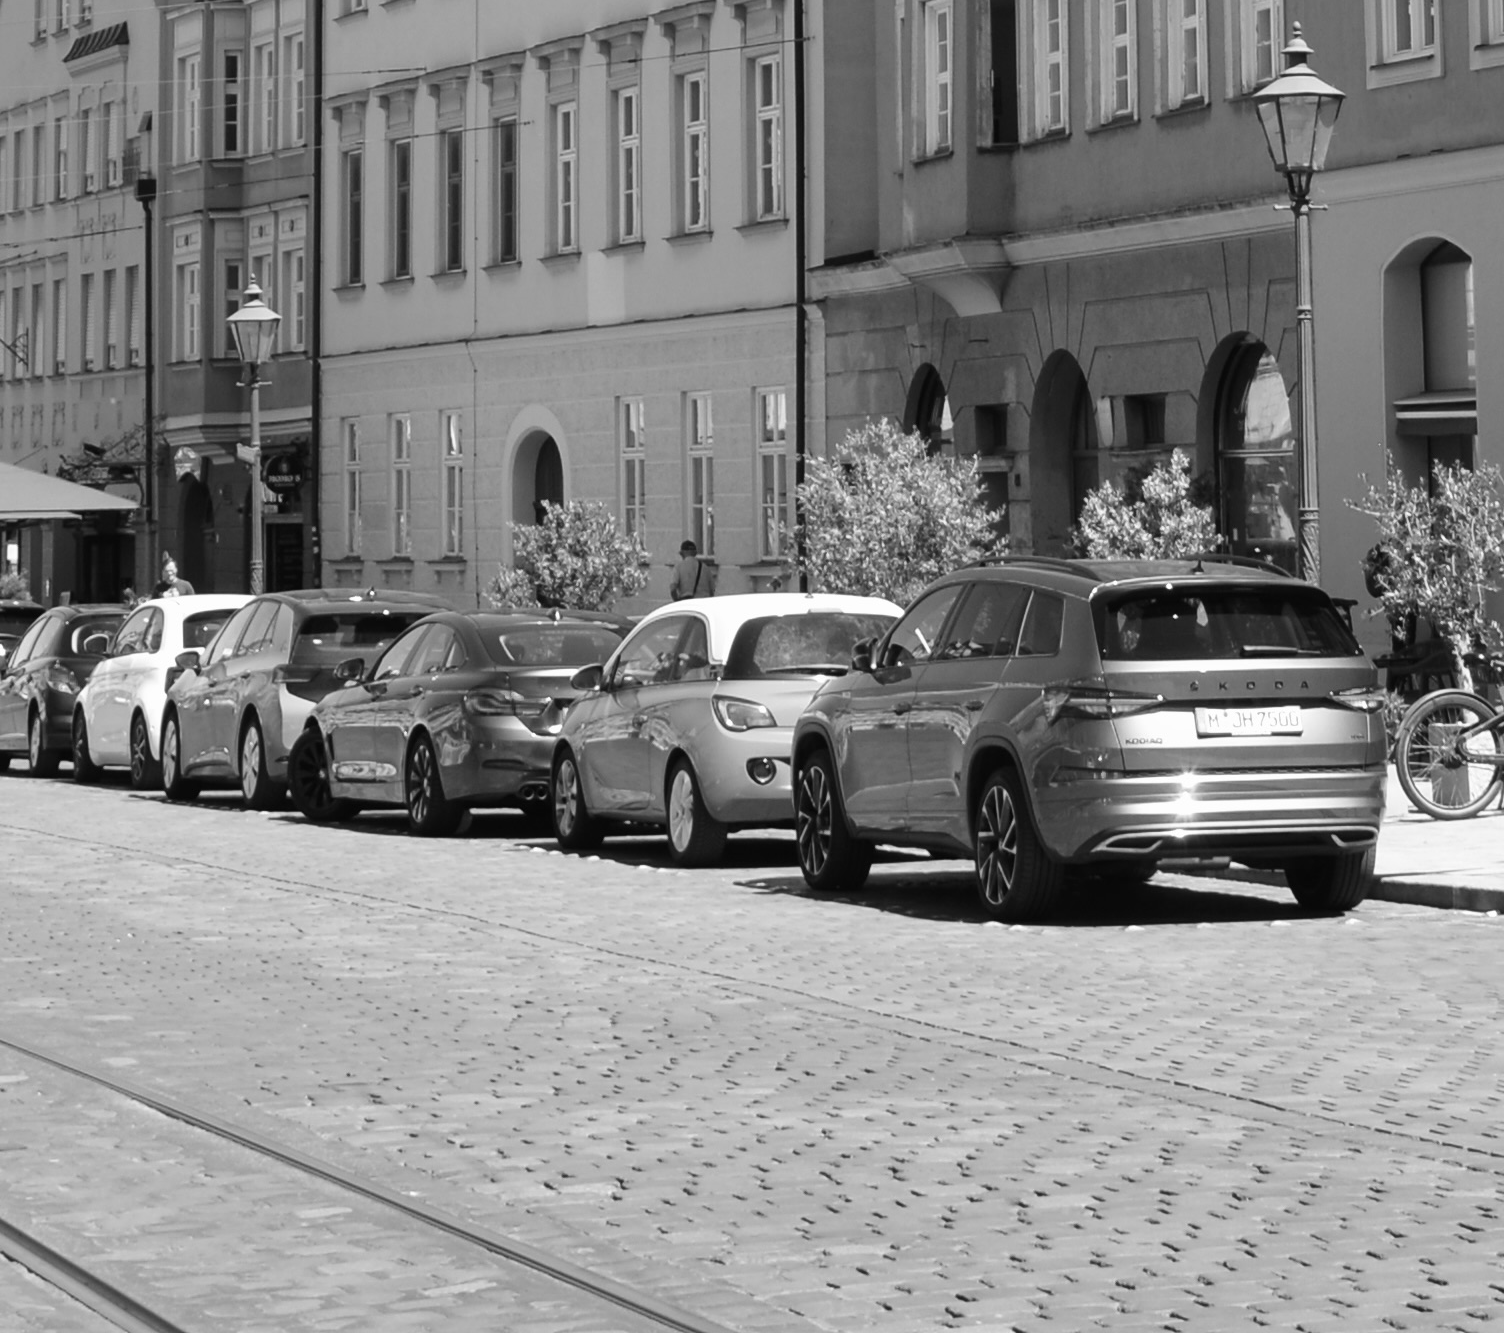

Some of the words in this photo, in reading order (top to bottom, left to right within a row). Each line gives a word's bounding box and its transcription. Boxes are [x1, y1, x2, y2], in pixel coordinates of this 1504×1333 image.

[1208, 713, 1220, 729] M
[1232, 711, 1253, 729] JH
[1258, 710, 1299, 728] 7500
[1125, 737, 1164, 745] KODIAQ
